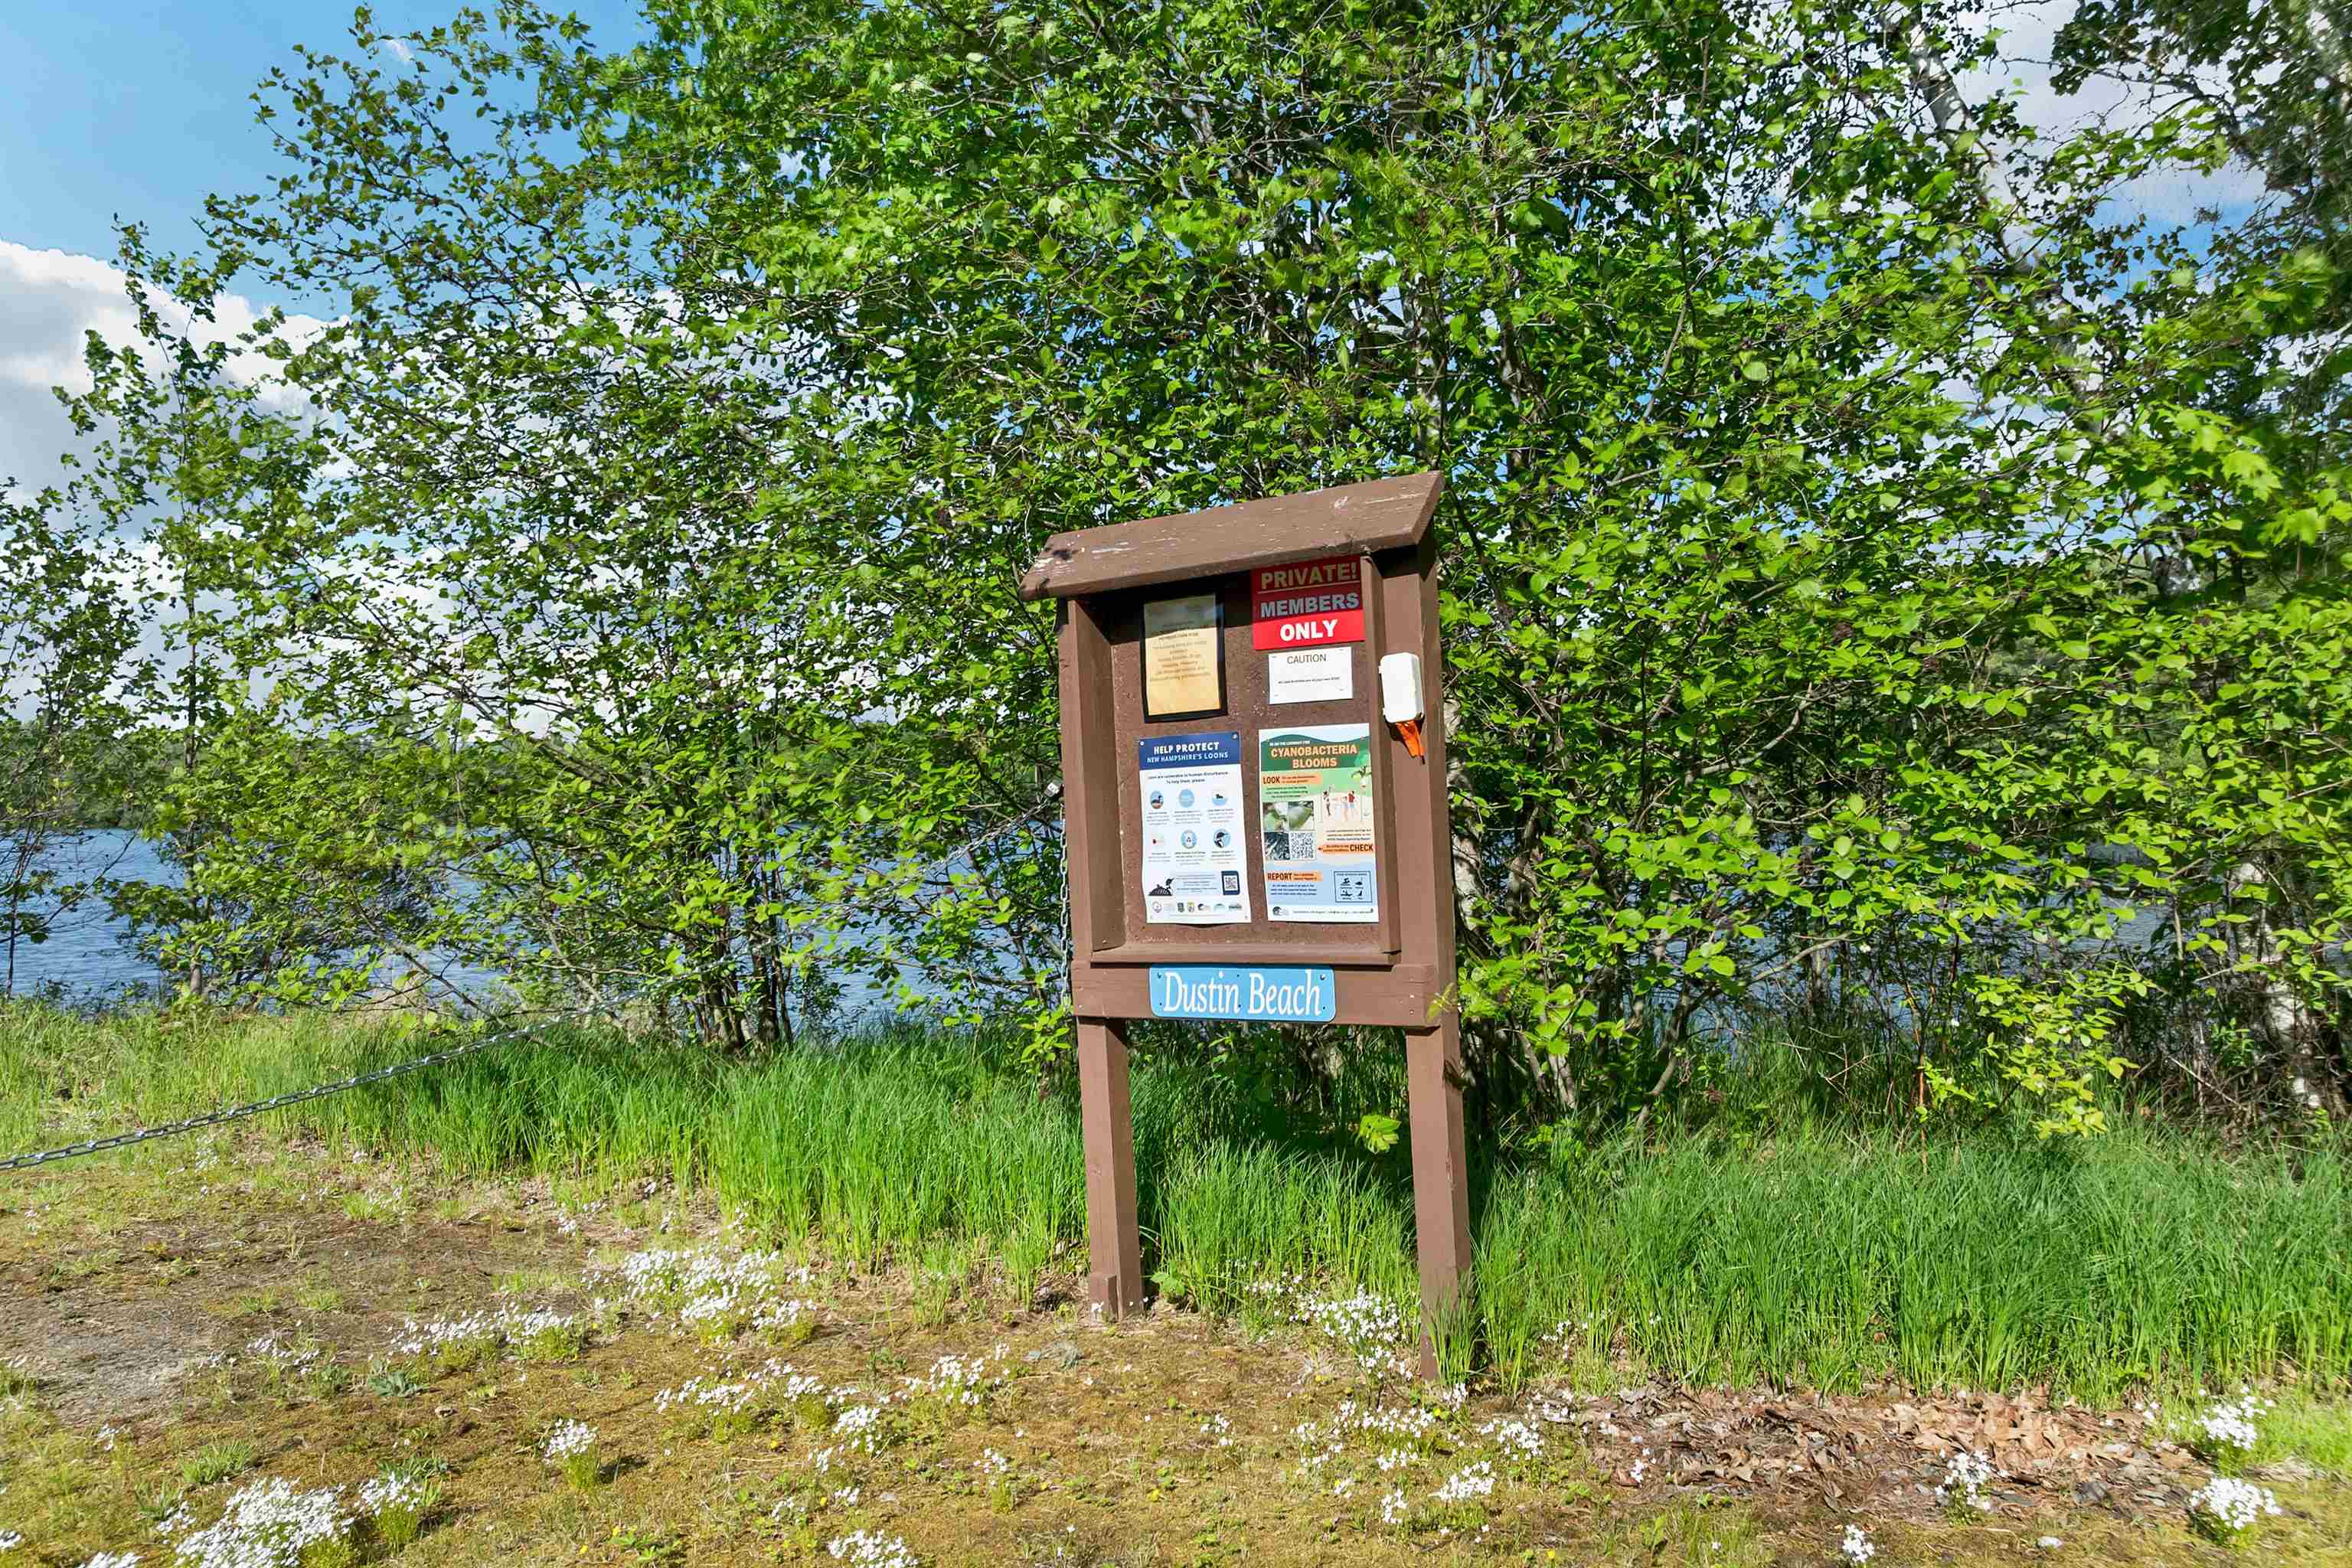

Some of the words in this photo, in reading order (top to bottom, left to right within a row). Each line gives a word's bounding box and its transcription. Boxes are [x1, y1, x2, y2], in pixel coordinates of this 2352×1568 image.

[1261, 562, 1357, 590] PRIVATE!
[1261, 593, 1359, 618] MEMBERS
[1280, 619, 1338, 642] ONLY
[1287, 654, 1327, 665] CAUTION
[1154, 745, 1174, 755] HELP
[1176, 742, 1220, 753] PROTECT
[1270, 744, 1357, 758] CYANOBACTERIA
[1161, 753, 1202, 762] HAMPSHIRE'S
[1204, 751, 1229, 760] LOONS
[1292, 757, 1338, 769] BLOOMS
[1263, 775, 1280, 785] LOOK
[1350, 844, 1373, 852] CHECK
[1267, 872, 1292, 881] REPORT
[1163, 970, 1241, 1014] Dustin
[1248, 968, 1321, 1016] Beach
